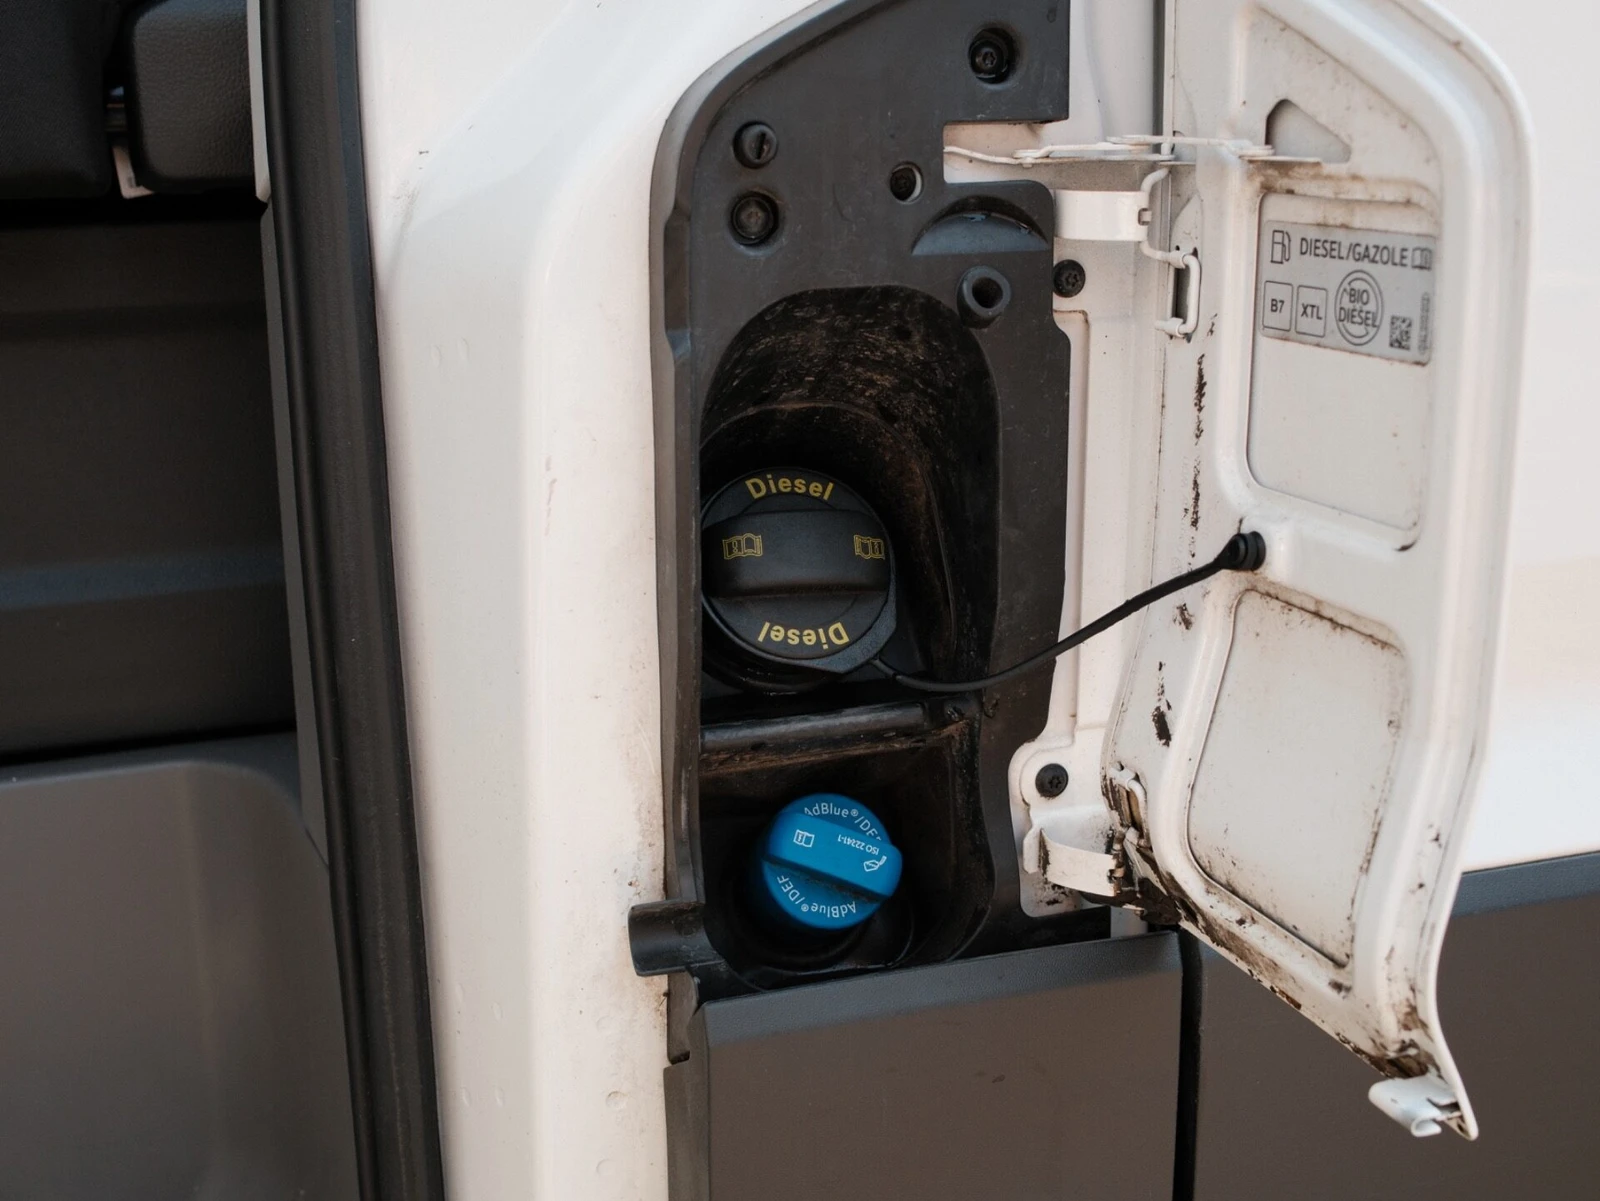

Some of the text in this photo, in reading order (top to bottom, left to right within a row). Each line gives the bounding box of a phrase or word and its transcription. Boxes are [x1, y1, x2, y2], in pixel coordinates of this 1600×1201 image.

[1300, 237, 1408, 267] DIESEL/GAZOLE
[1270, 298, 1285, 314] B7
[1349, 287, 1370, 306] BIO
[1301, 303, 1323, 320] XTL
[1338, 306, 1379, 328] DIESEL
[745, 474, 834, 500] Diesel
[757, 621, 850, 650] Diesel
[865, 845, 880, 856] ISO
